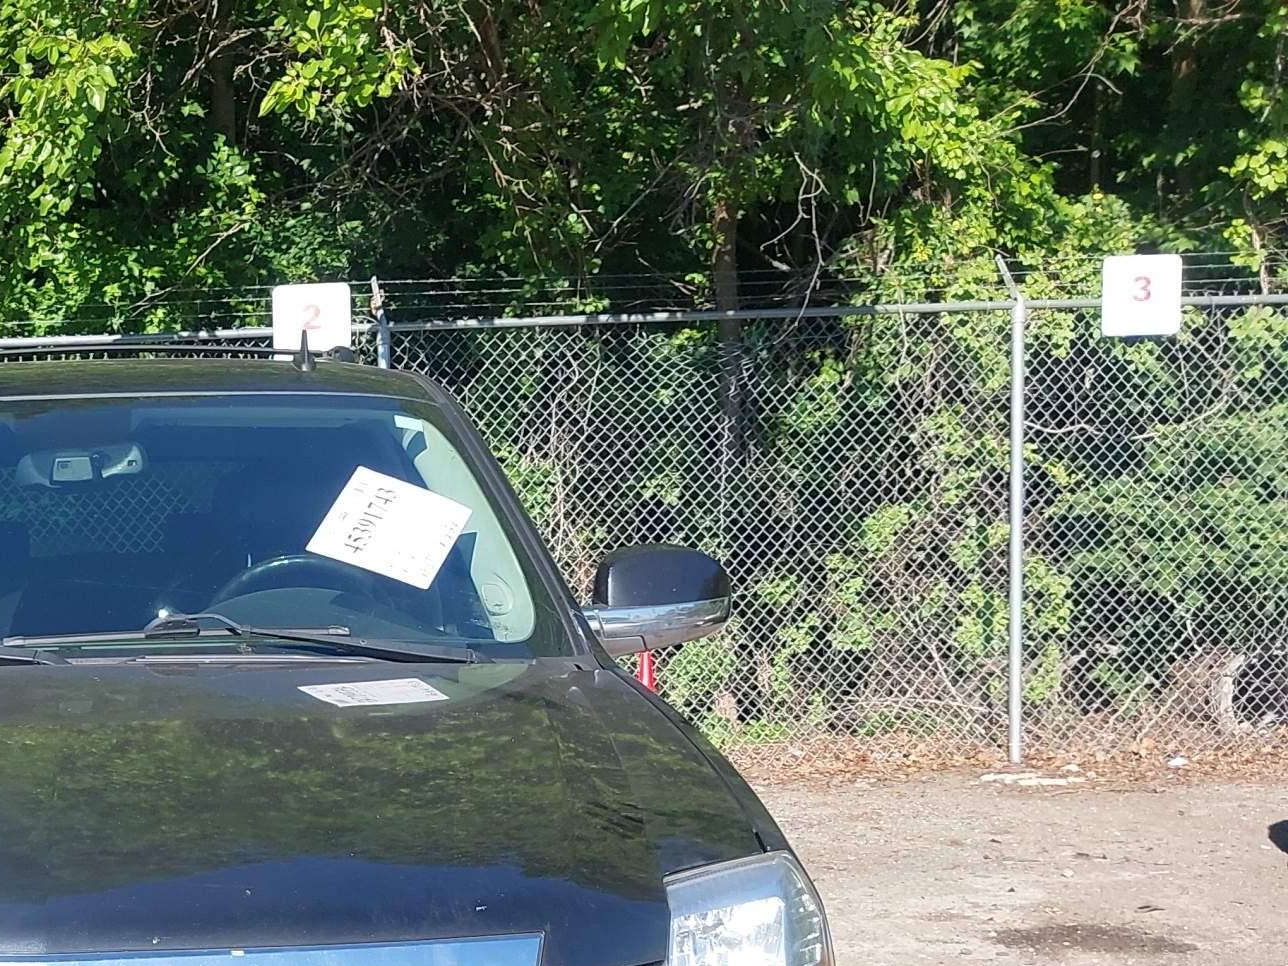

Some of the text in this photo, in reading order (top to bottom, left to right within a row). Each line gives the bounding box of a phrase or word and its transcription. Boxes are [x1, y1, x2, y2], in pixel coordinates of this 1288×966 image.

[1133, 275, 1152, 302] 3
[303, 303, 322, 330] 2
[343, 486, 397, 555] 45391743
